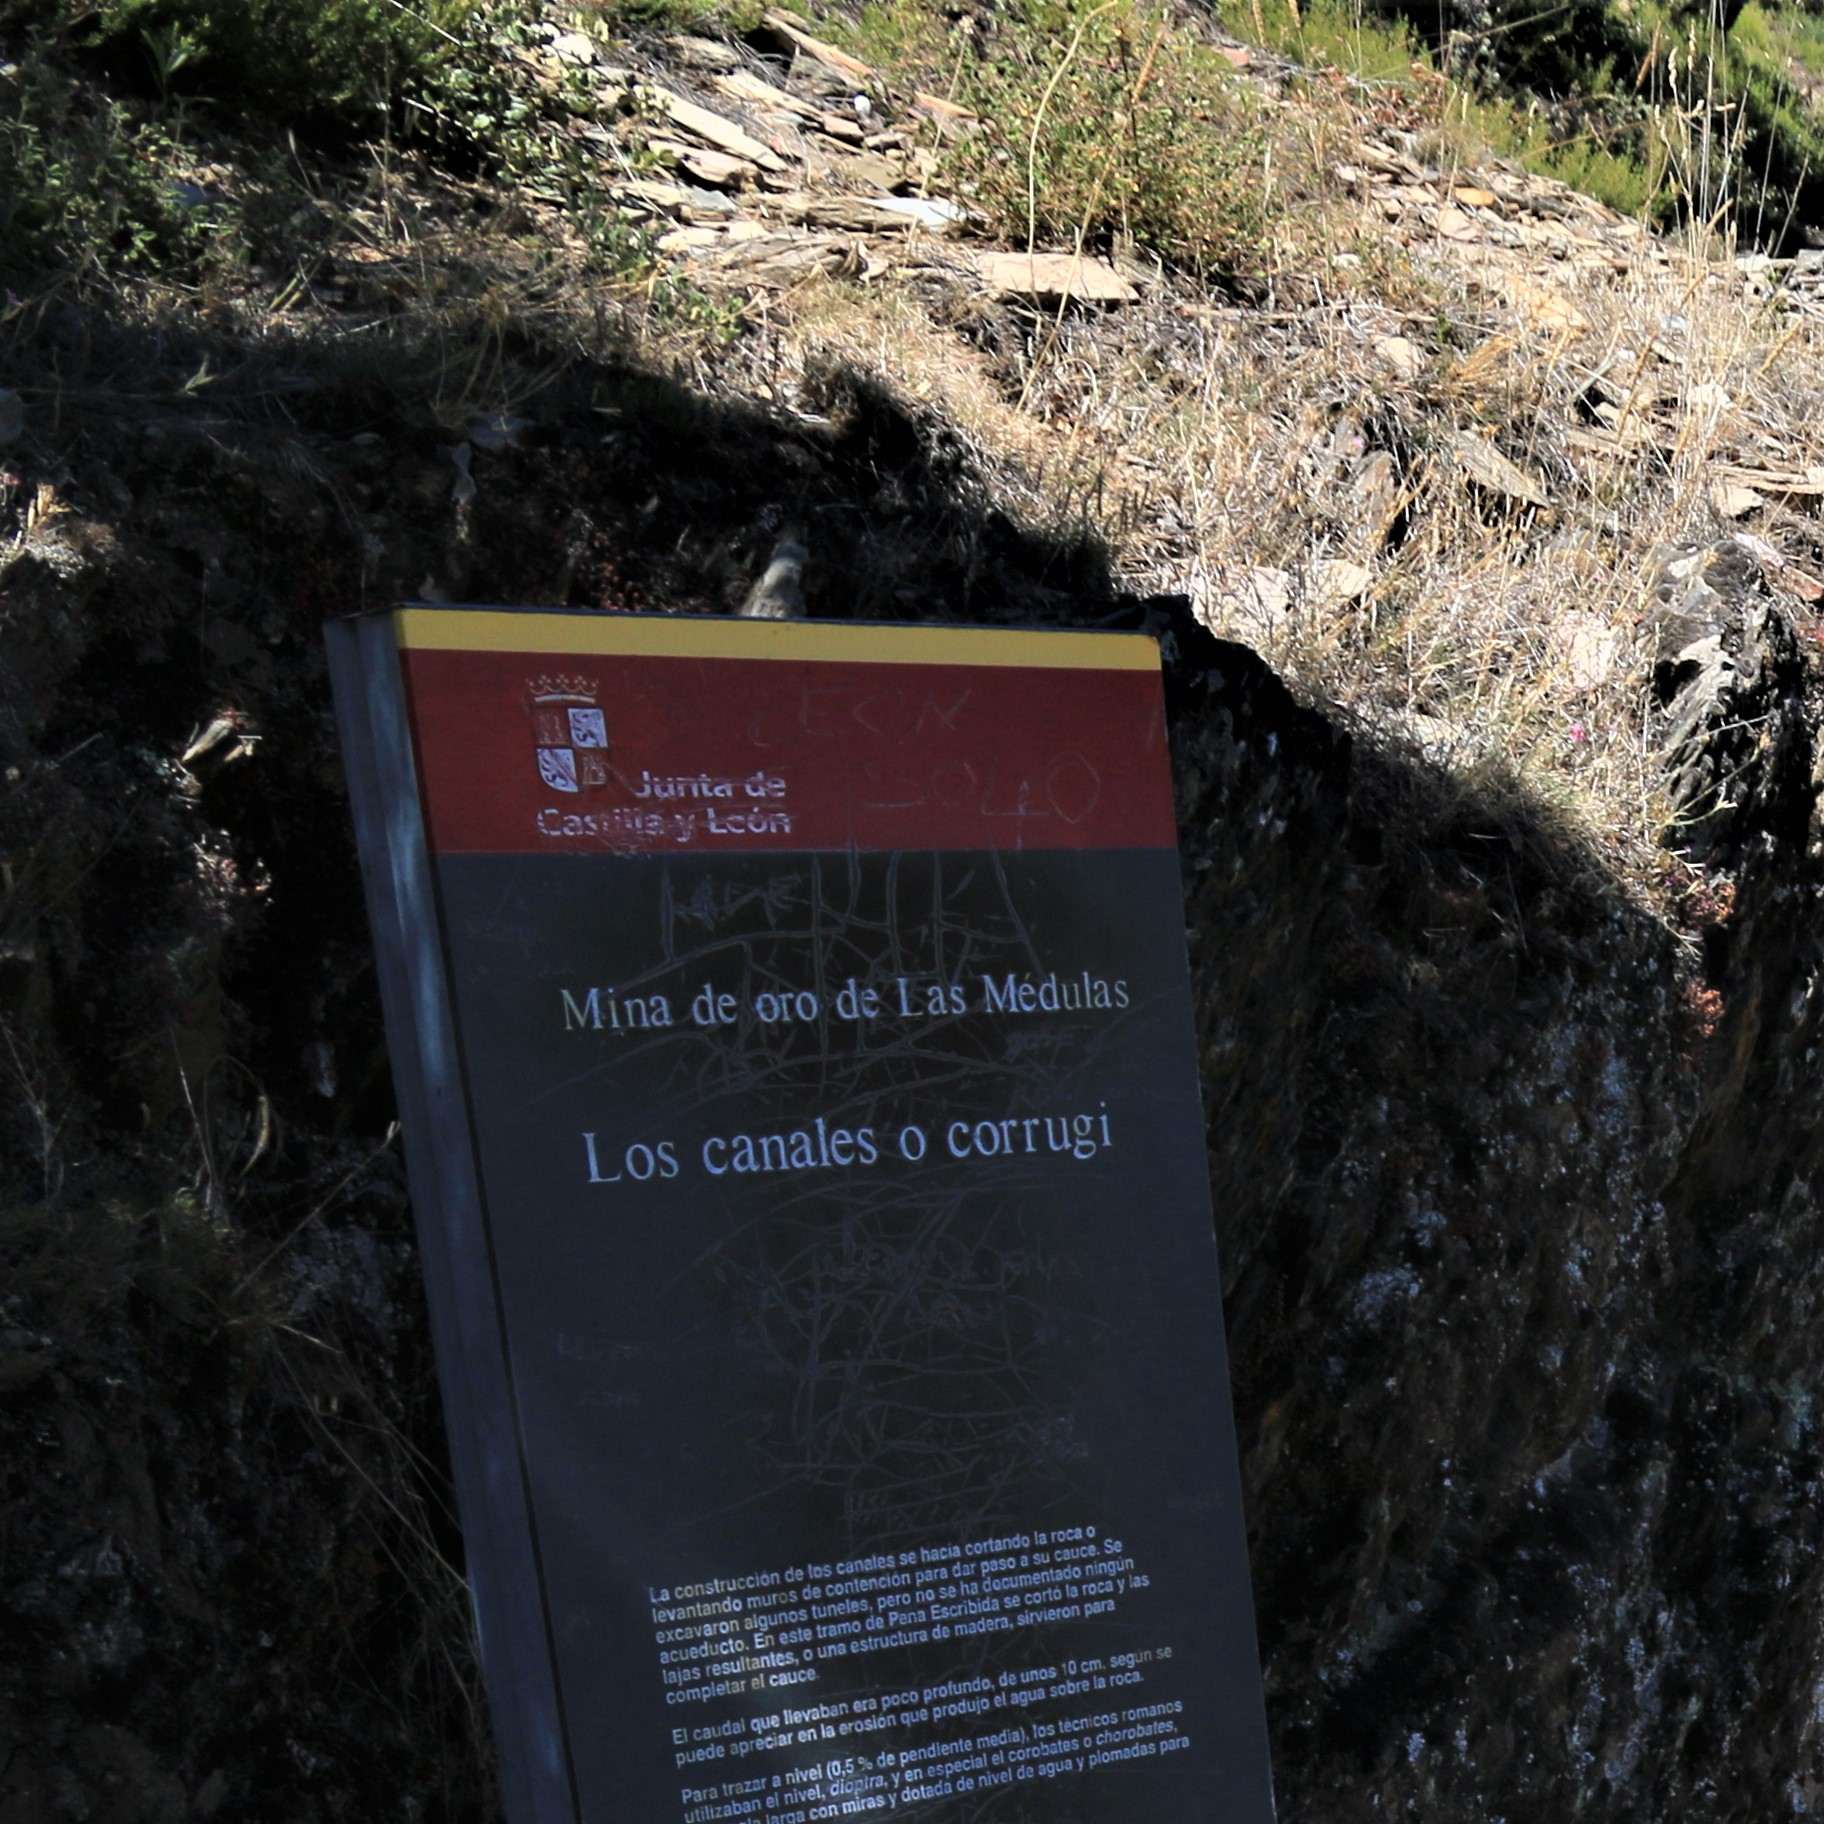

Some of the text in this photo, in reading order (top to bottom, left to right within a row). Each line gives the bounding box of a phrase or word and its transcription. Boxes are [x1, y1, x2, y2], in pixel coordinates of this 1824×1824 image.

[634, 771, 785, 798] Junta de
[560, 971, 1130, 1031] Mina de oro de Las Médulas
[582, 1101, 1113, 1184] Los canales o corrugi
[644, 1527, 1083, 1603] La construcción de los canales se cortando la roca
[652, 1595, 742, 1623] levantando
[746, 1589, 797, 1609] muros
[801, 1583, 822, 1600] de
[825, 1571, 910, 1597] contención
[914, 1566, 948, 1587] para
[951, 1561, 976, 1578] dar
[979, 1556, 1016, 1578] paso
[1031, 1552, 1050, 1565] su
[1103, 1538, 1122, 1554] Se
[655, 1555, 1134, 1644] excavaron algunos pero no se ha documentado ningún
[659, 1637, 748, 1664] acueducto.
[753, 1630, 774, 1649] En
[778, 1627, 812, 1645] este
[815, 1620, 861, 1639] tramo
[864, 1614, 884, 1631] de
[929, 1595, 999, 1621] Escribida
[1002, 1594, 1021, 1608] se
[1064, 1583, 1079, 1598] la
[1081, 1579, 1113, 1595] roca
[1128, 1574, 1150, 1588] las
[662, 1598, 1115, 1686] lajas resultantes, o una estructura de madera, sirvieron para
[665, 1679, 745, 1704] completar
[750, 1672, 765, 1689] el
[671, 1727, 688, 1744] El
[692, 1717, 745, 1741] caudal
[749, 1714, 780, 1734] que
[783, 1702, 848, 1725] llevaban
[852, 1697, 877, 1713] era
[880, 1690, 919, 1712] poco
[922, 1675, 994, 1704] profundo,
[998, 1670, 1017, 1687] de
[1019, 1666, 1057, 1683] unos
[1080, 1658, 1105, 1673] cm.
[1155, 1646, 1172, 1659] se
[675, 1670, 1143, 1768] puede apreciar en la erosión que produjo el agua sobre la roca.
[681, 1786, 718, 1804] Para
[722, 1776, 766, 1796] trazar
[771, 1774, 781, 1788] a
[785, 1762, 822, 1784] nivel
[876, 1751, 895, 1768] de
[899, 1737, 972, 1768] pendiente
[976, 1726, 1029, 1749] media),
[1031, 1723, 1055, 1739] los
[1122, 1699, 1182, 1721] romanos
[684, 1798, 761, 1824] utilizaban
[765, 1791, 779, 1808] el
[783, 1783, 825, 1804] nivel,
[890, 1771, 900, 1788] y
[903, 1767, 923, 1782] en
[926, 1752, 987, 1780] especial
[990, 1749, 1004, 1765] el
[1007, 1738, 1079, 1762] corobates
[1082, 1735, 1092, 1748] o
[808, 1803, 839, 1820] con
[841, 1794, 885, 1814] miras
[887, 1792, 897, 1808] y
[900, 1779, 952, 1802] dotada
[955, 1775, 974, 1791] de
[977, 1766, 1012, 1787] nivel
[1015, 1763, 1034, 1780] de
[1037, 1758, 1073, 1778] agua
[1075, 1756, 1084, 1772] y
[1088, 1741, 1156, 1769] plomadas
[1159, 1735, 1189, 1755] para
